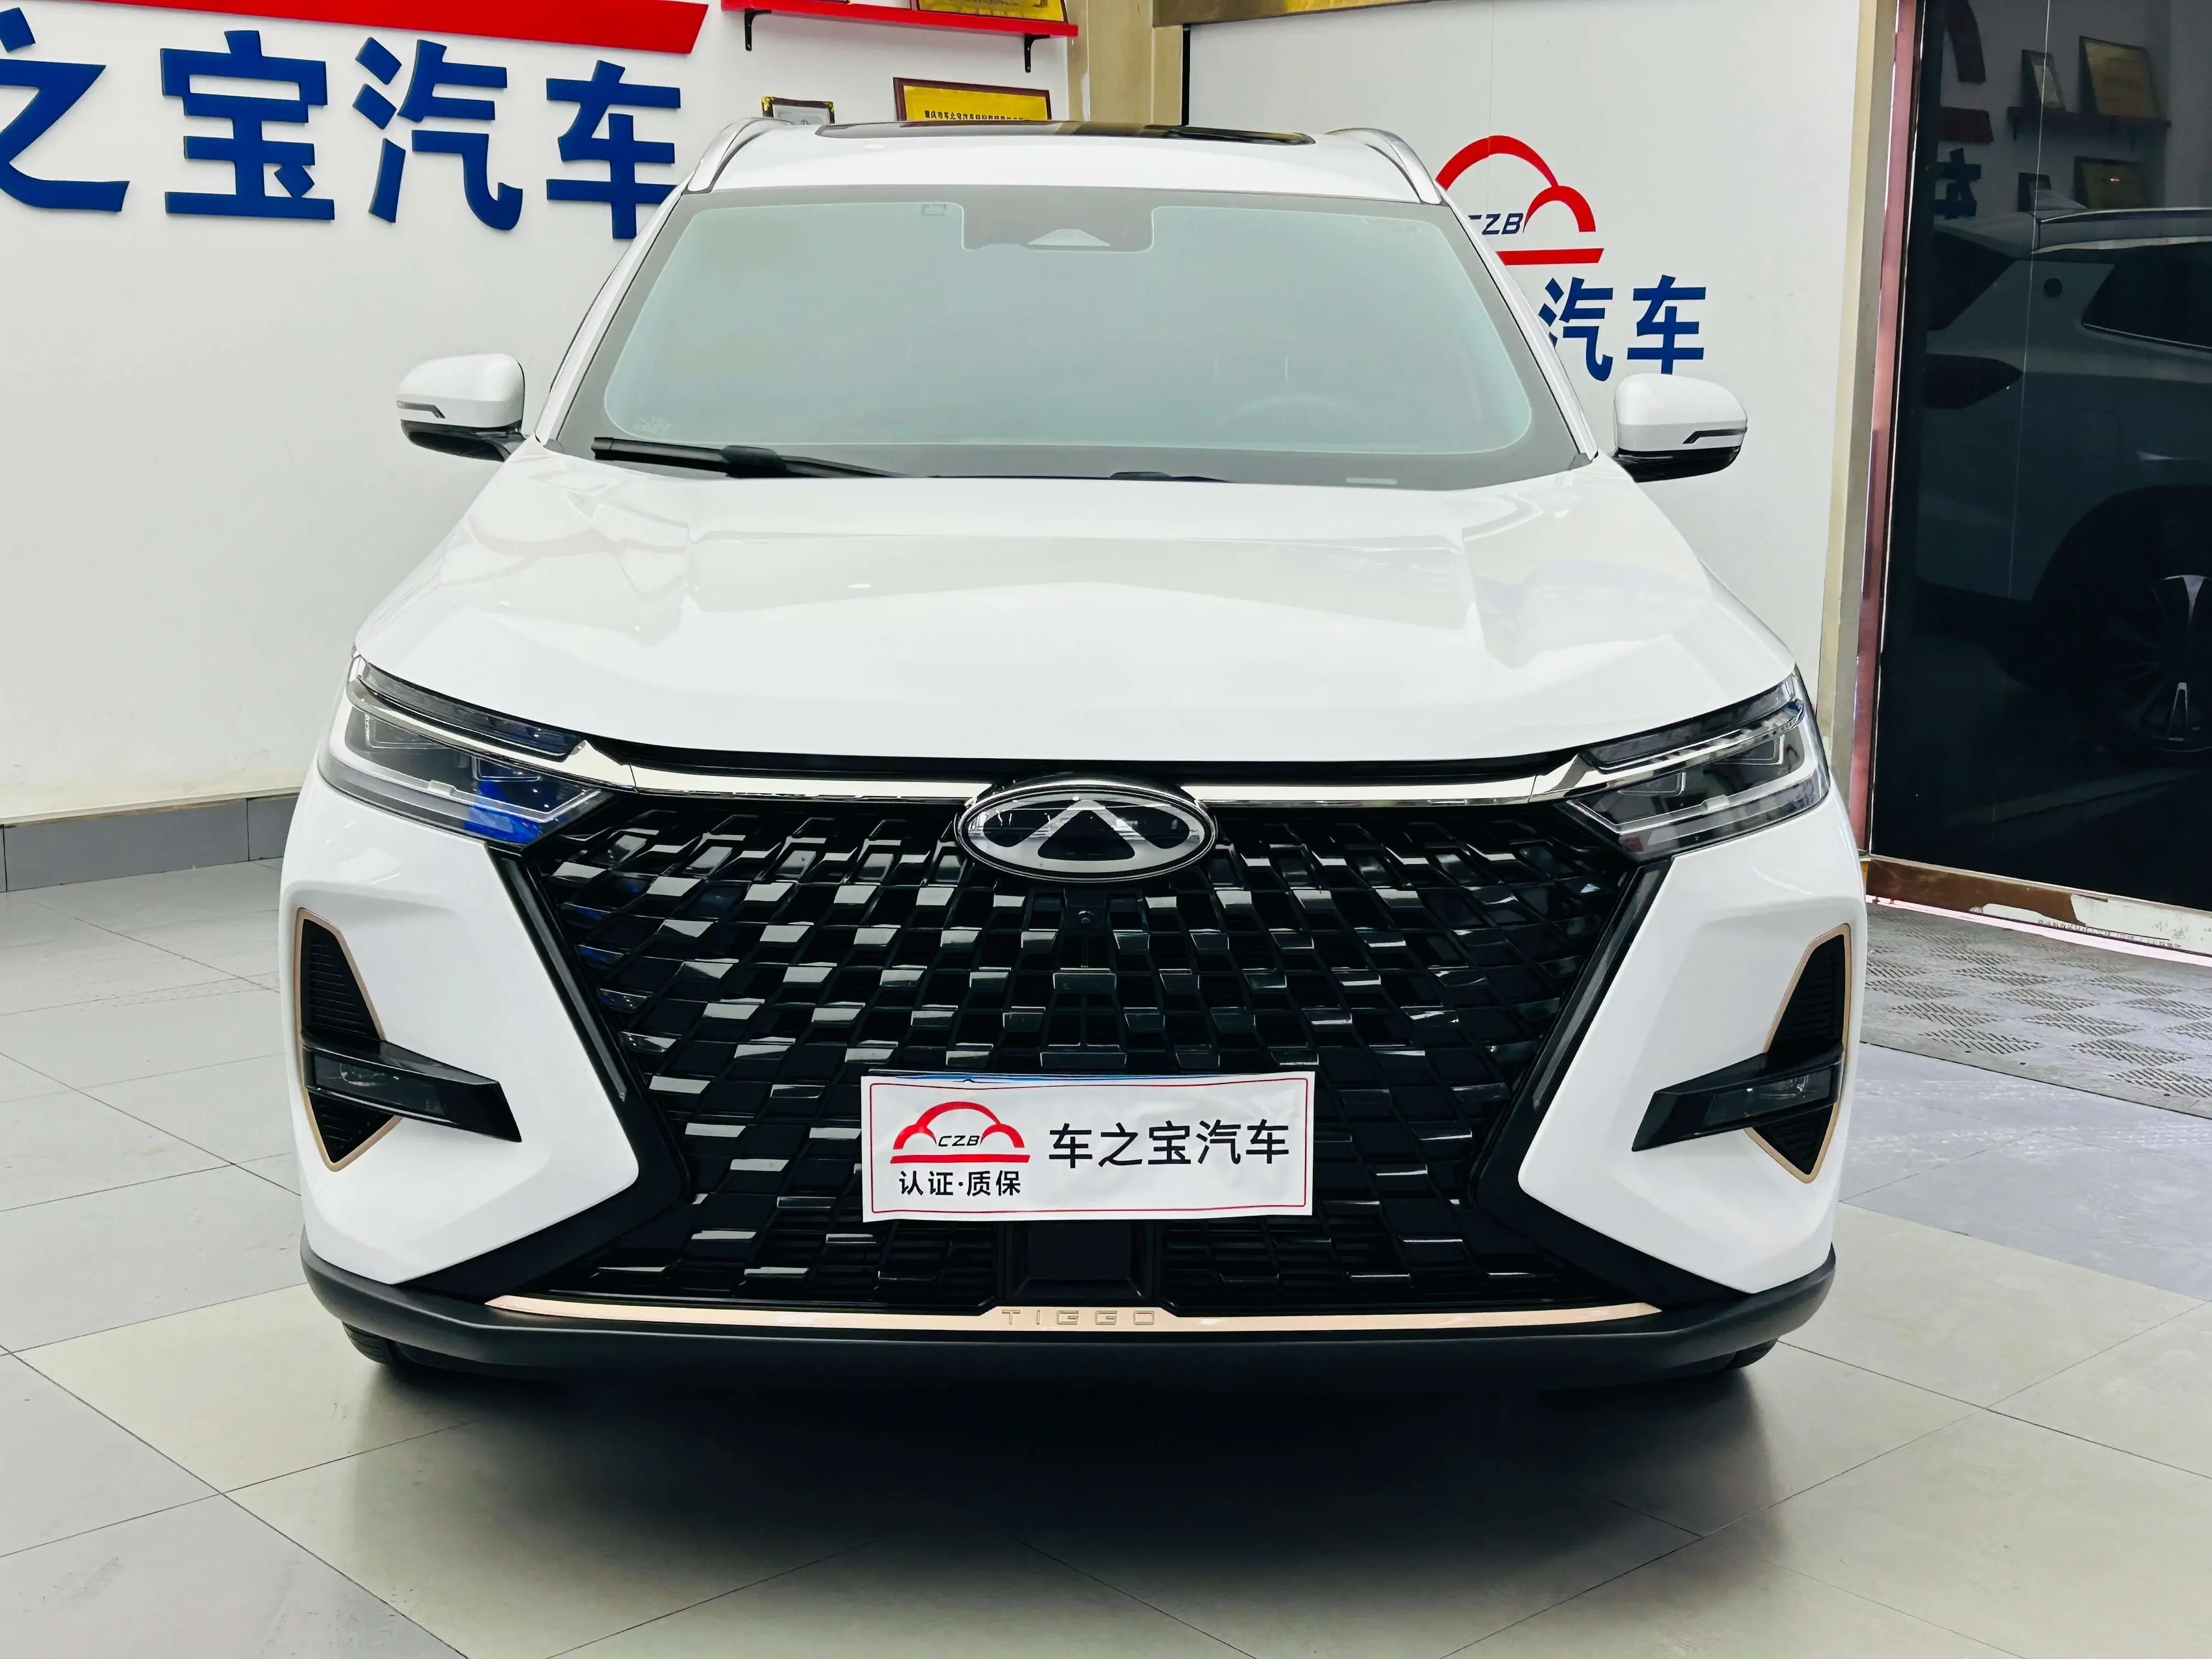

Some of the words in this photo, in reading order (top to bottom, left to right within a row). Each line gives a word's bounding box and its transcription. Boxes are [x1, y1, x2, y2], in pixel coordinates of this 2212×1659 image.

[0, 8, 681, 240] 之宝汽车
[1467, 212, 1523, 235] ZB
[1538, 275, 1706, 381] 汽车
[938, 1135, 980, 1147] CZB
[1048, 1119, 1289, 1169] 车之宝汽车
[899, 1170, 1021, 1197] 认证·质保
[1002, 1309, 1155, 1325] TIGGO
